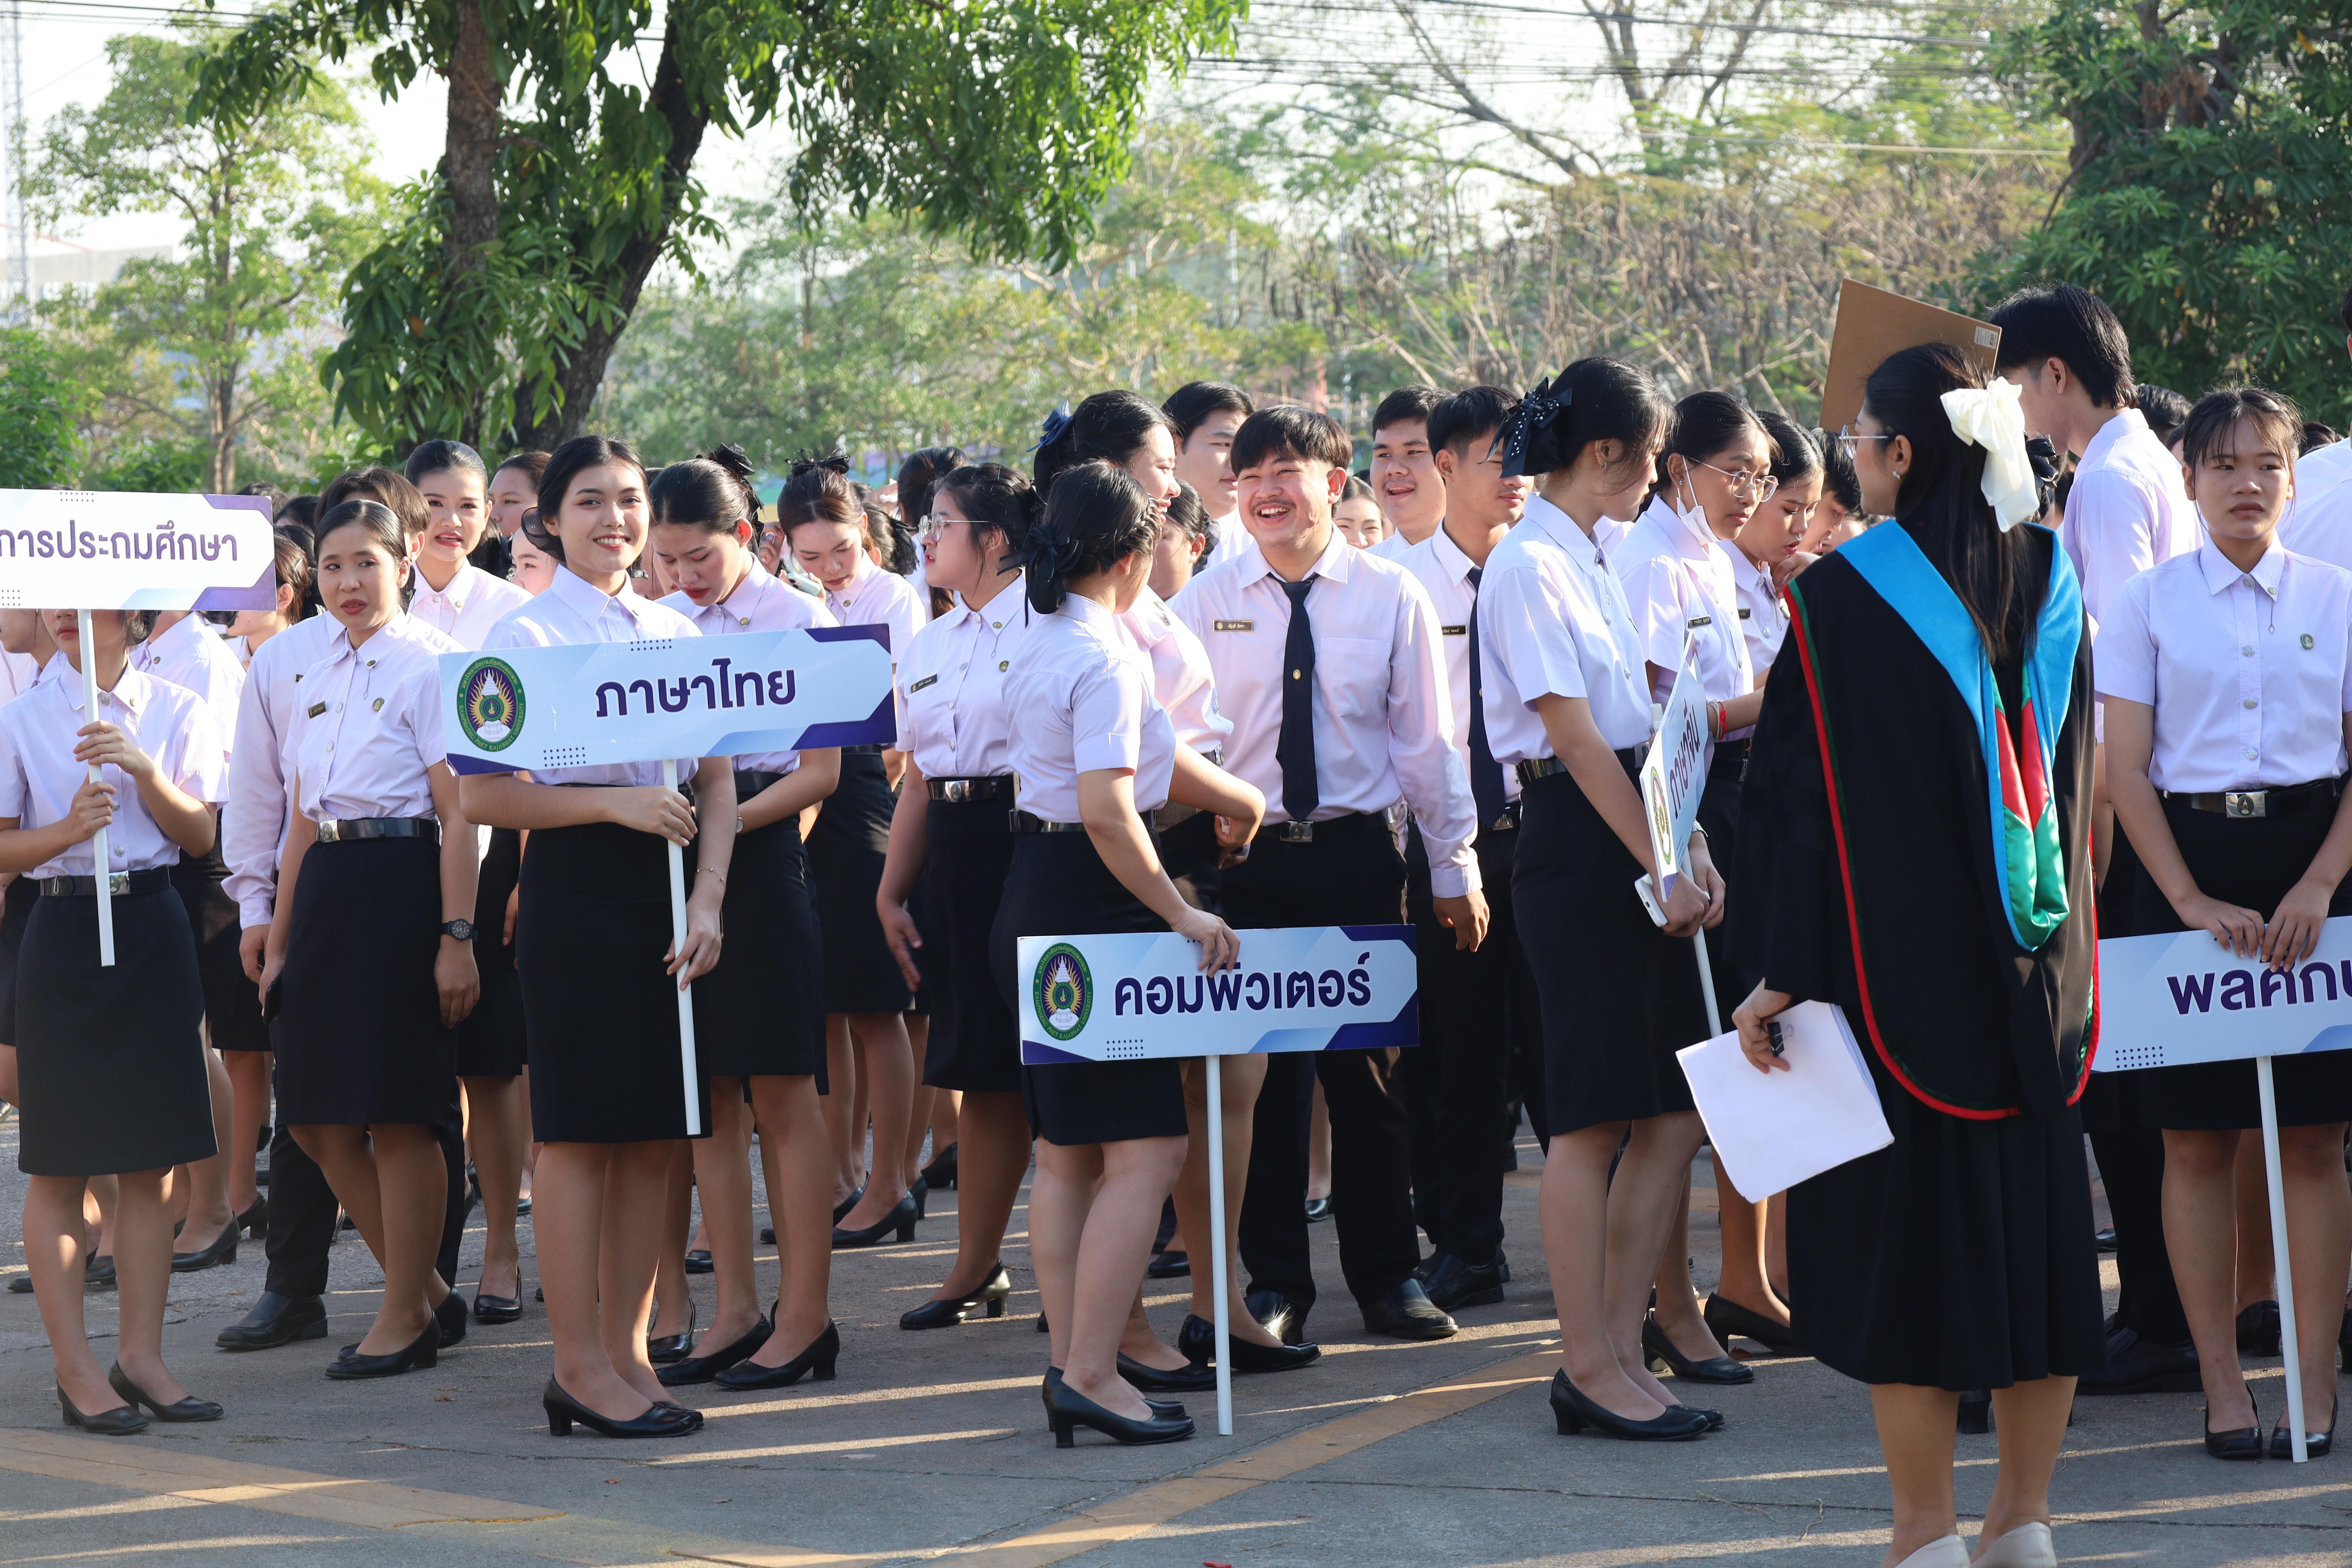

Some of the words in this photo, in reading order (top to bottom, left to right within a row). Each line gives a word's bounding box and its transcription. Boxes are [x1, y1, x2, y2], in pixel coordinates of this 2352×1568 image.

[0, 520, 237, 561] การประถมศึกษา
[596, 658, 795, 718] ภาษาไทย
[459, 705, 475, 739] KAMPHAENG
[475, 738, 488, 749] PHET
[489, 735, 514, 751] RAJABHAT
[513, 703, 524, 735] UNIVERSITY
[1669, 697, 1700, 820] ภาษาจีน
[1115, 951, 1371, 1015] คอมพิวเตอร์
[1035, 991, 1048, 1027] KAMPHAENG
[1047, 1026, 1059, 1037] PHET
[1060, 1024, 1082, 1040] RAJABHAT
[1081, 991, 1092, 1025] UNIVERSITY
